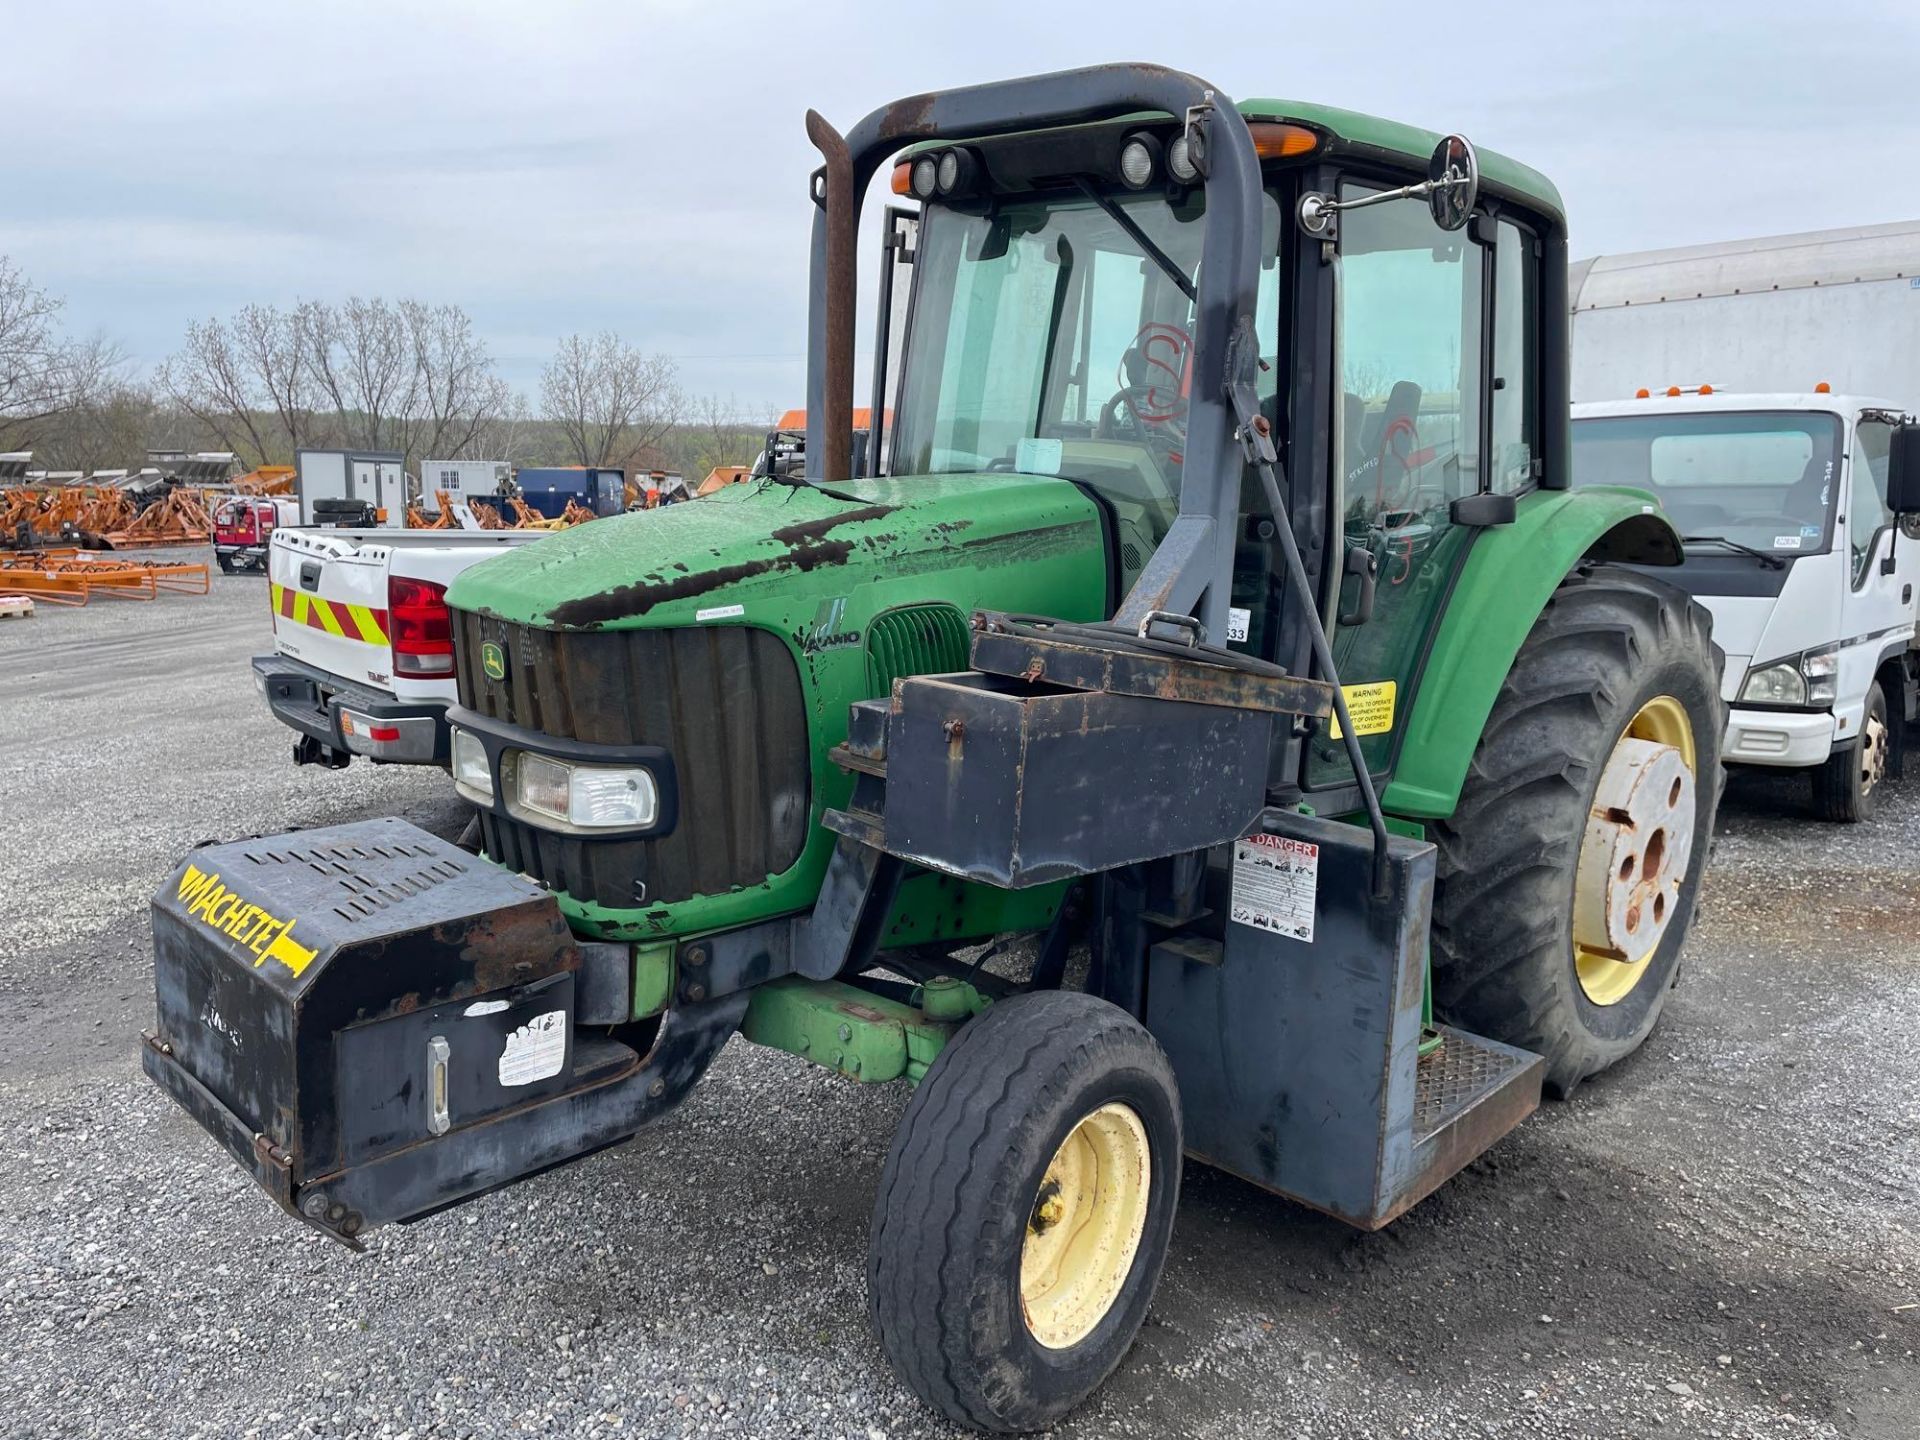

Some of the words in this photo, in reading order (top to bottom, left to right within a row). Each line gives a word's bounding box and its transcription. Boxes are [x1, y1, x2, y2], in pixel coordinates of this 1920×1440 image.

[1353, 688, 1382, 698] WARNING
[1350, 708, 1375, 716] EQUIPMENT
[1257, 834, 1312, 856] DANGER
[178, 865, 285, 955] MACHETE
